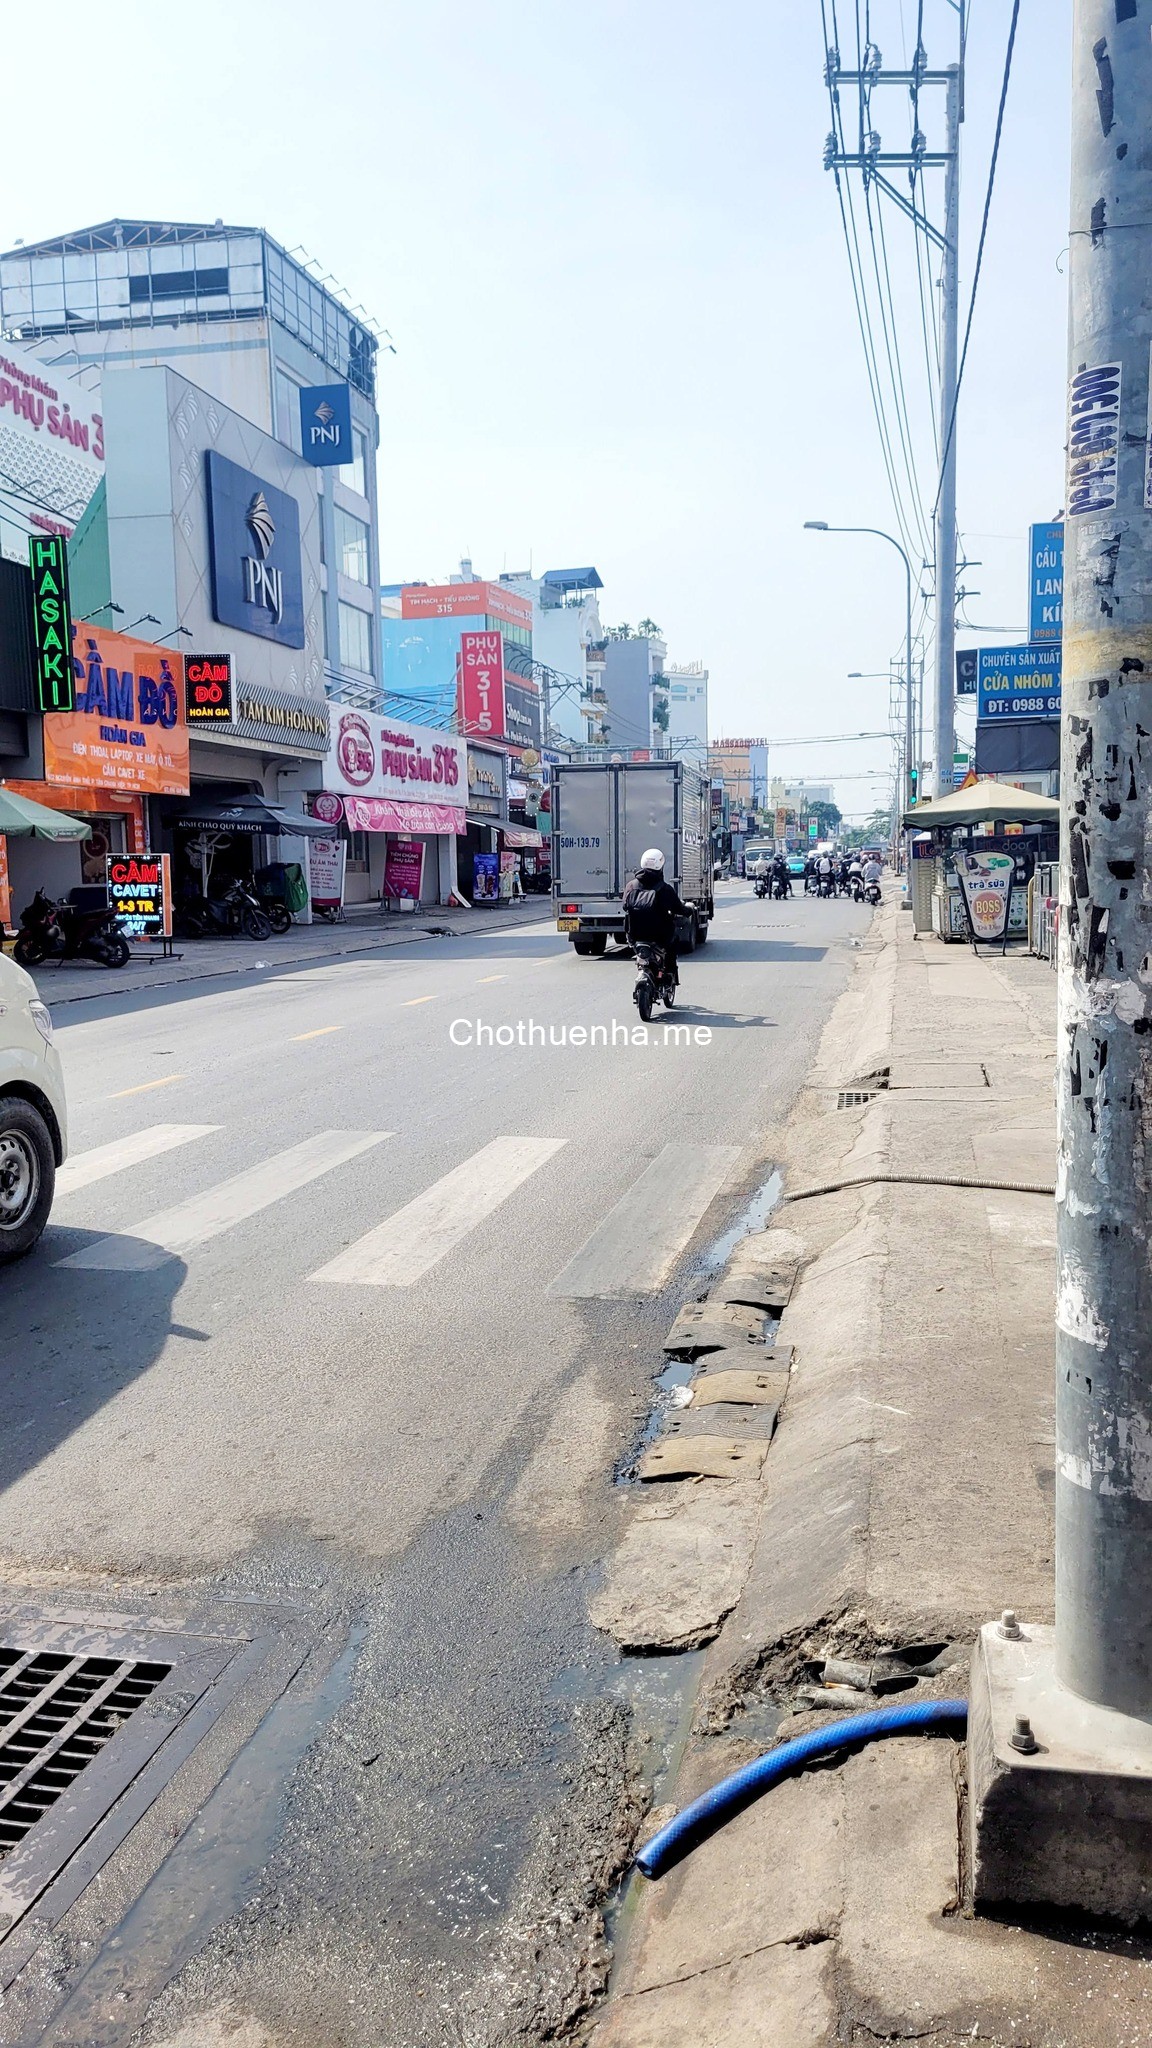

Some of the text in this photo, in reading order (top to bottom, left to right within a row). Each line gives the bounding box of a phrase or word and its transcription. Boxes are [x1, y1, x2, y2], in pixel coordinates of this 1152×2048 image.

[0, 377, 44, 432] PHỤ
[47, 402, 89, 452] SẢN
[310, 425, 340, 447] PNJ
[1036, 544, 1056, 568] CẦU
[243, 556, 283, 625] PNJ
[437, 604, 453, 613] 315
[37, 541, 63, 705] HASAKI
[1034, 629, 1056, 638] 0988
[466, 636, 497, 652] PHỤ
[466, 649, 498, 666] SẢN
[982, 648, 1060, 668] CHUYÊN SẢN XUẤT
[188, 662, 228, 682] CẦM
[983, 672, 1010, 691] CỬA
[1014, 669, 1053, 690] NHÔM
[138, 660, 178, 730] ĐỒ
[195, 683, 222, 702] ĐỒ
[476, 670, 492, 731] 315
[190, 707, 229, 716] HOÀN GIA
[988, 699, 1009, 713] ĐT:
[1012, 697, 1044, 711] 0988
[266, 704, 285, 726] KIM
[286, 708, 312, 733] HOÀN
[100, 724, 146, 747] HOÀN GIA
[102, 763, 146, 780] CẦM CAVET XE
[382, 749, 407, 784] PHỤ
[408, 746, 432, 782] SẢN
[432, 744, 459, 786] 315
[375, 803, 394, 815] Khám
[178, 820, 262, 832] KÍNH CHÀO QUÝ KHÁCH
[561, 837, 600, 848] 50H-139.79
[1002, 839, 1033, 851] door
[112, 860, 158, 882] CẦM
[113, 884, 158, 897] CAVET
[968, 879, 1005, 889] trà sữa
[117, 900, 154, 912] 1-3 TR
[976, 899, 1000, 914] BOSS
